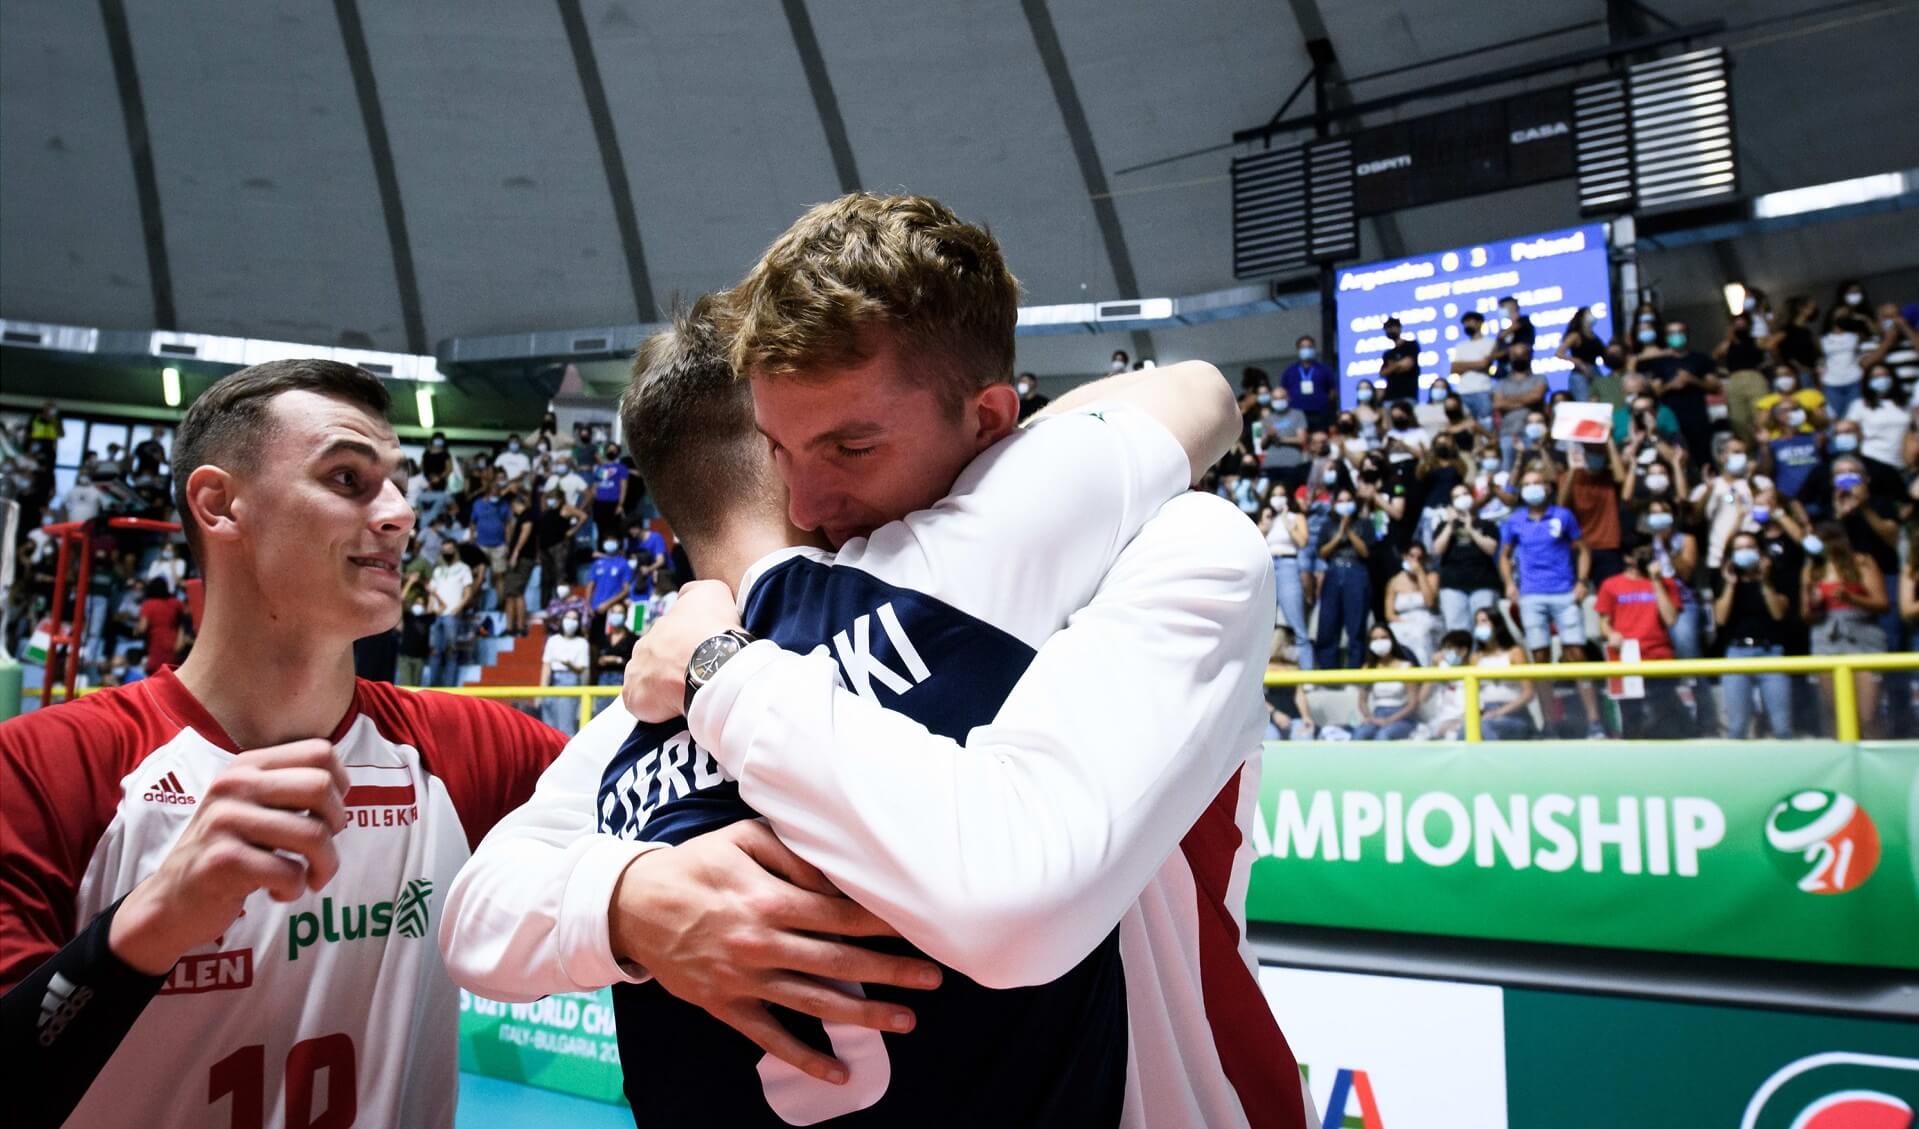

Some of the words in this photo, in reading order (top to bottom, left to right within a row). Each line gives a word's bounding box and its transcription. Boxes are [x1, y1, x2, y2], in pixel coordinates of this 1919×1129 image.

[1510, 122, 1568, 143] CASA
[1340, 262, 1434, 291] Argentina
[1471, 247, 1487, 267] 3
[1511, 231, 1585, 261] Poland
[144, 790, 196, 804] adidas
[1797, 838, 1854, 892] 21
[288, 897, 394, 961] plus
[161, 955, 245, 990] LEN
[511, 998, 579, 1030] WORLD
[599, 1041, 620, 1063] 20
